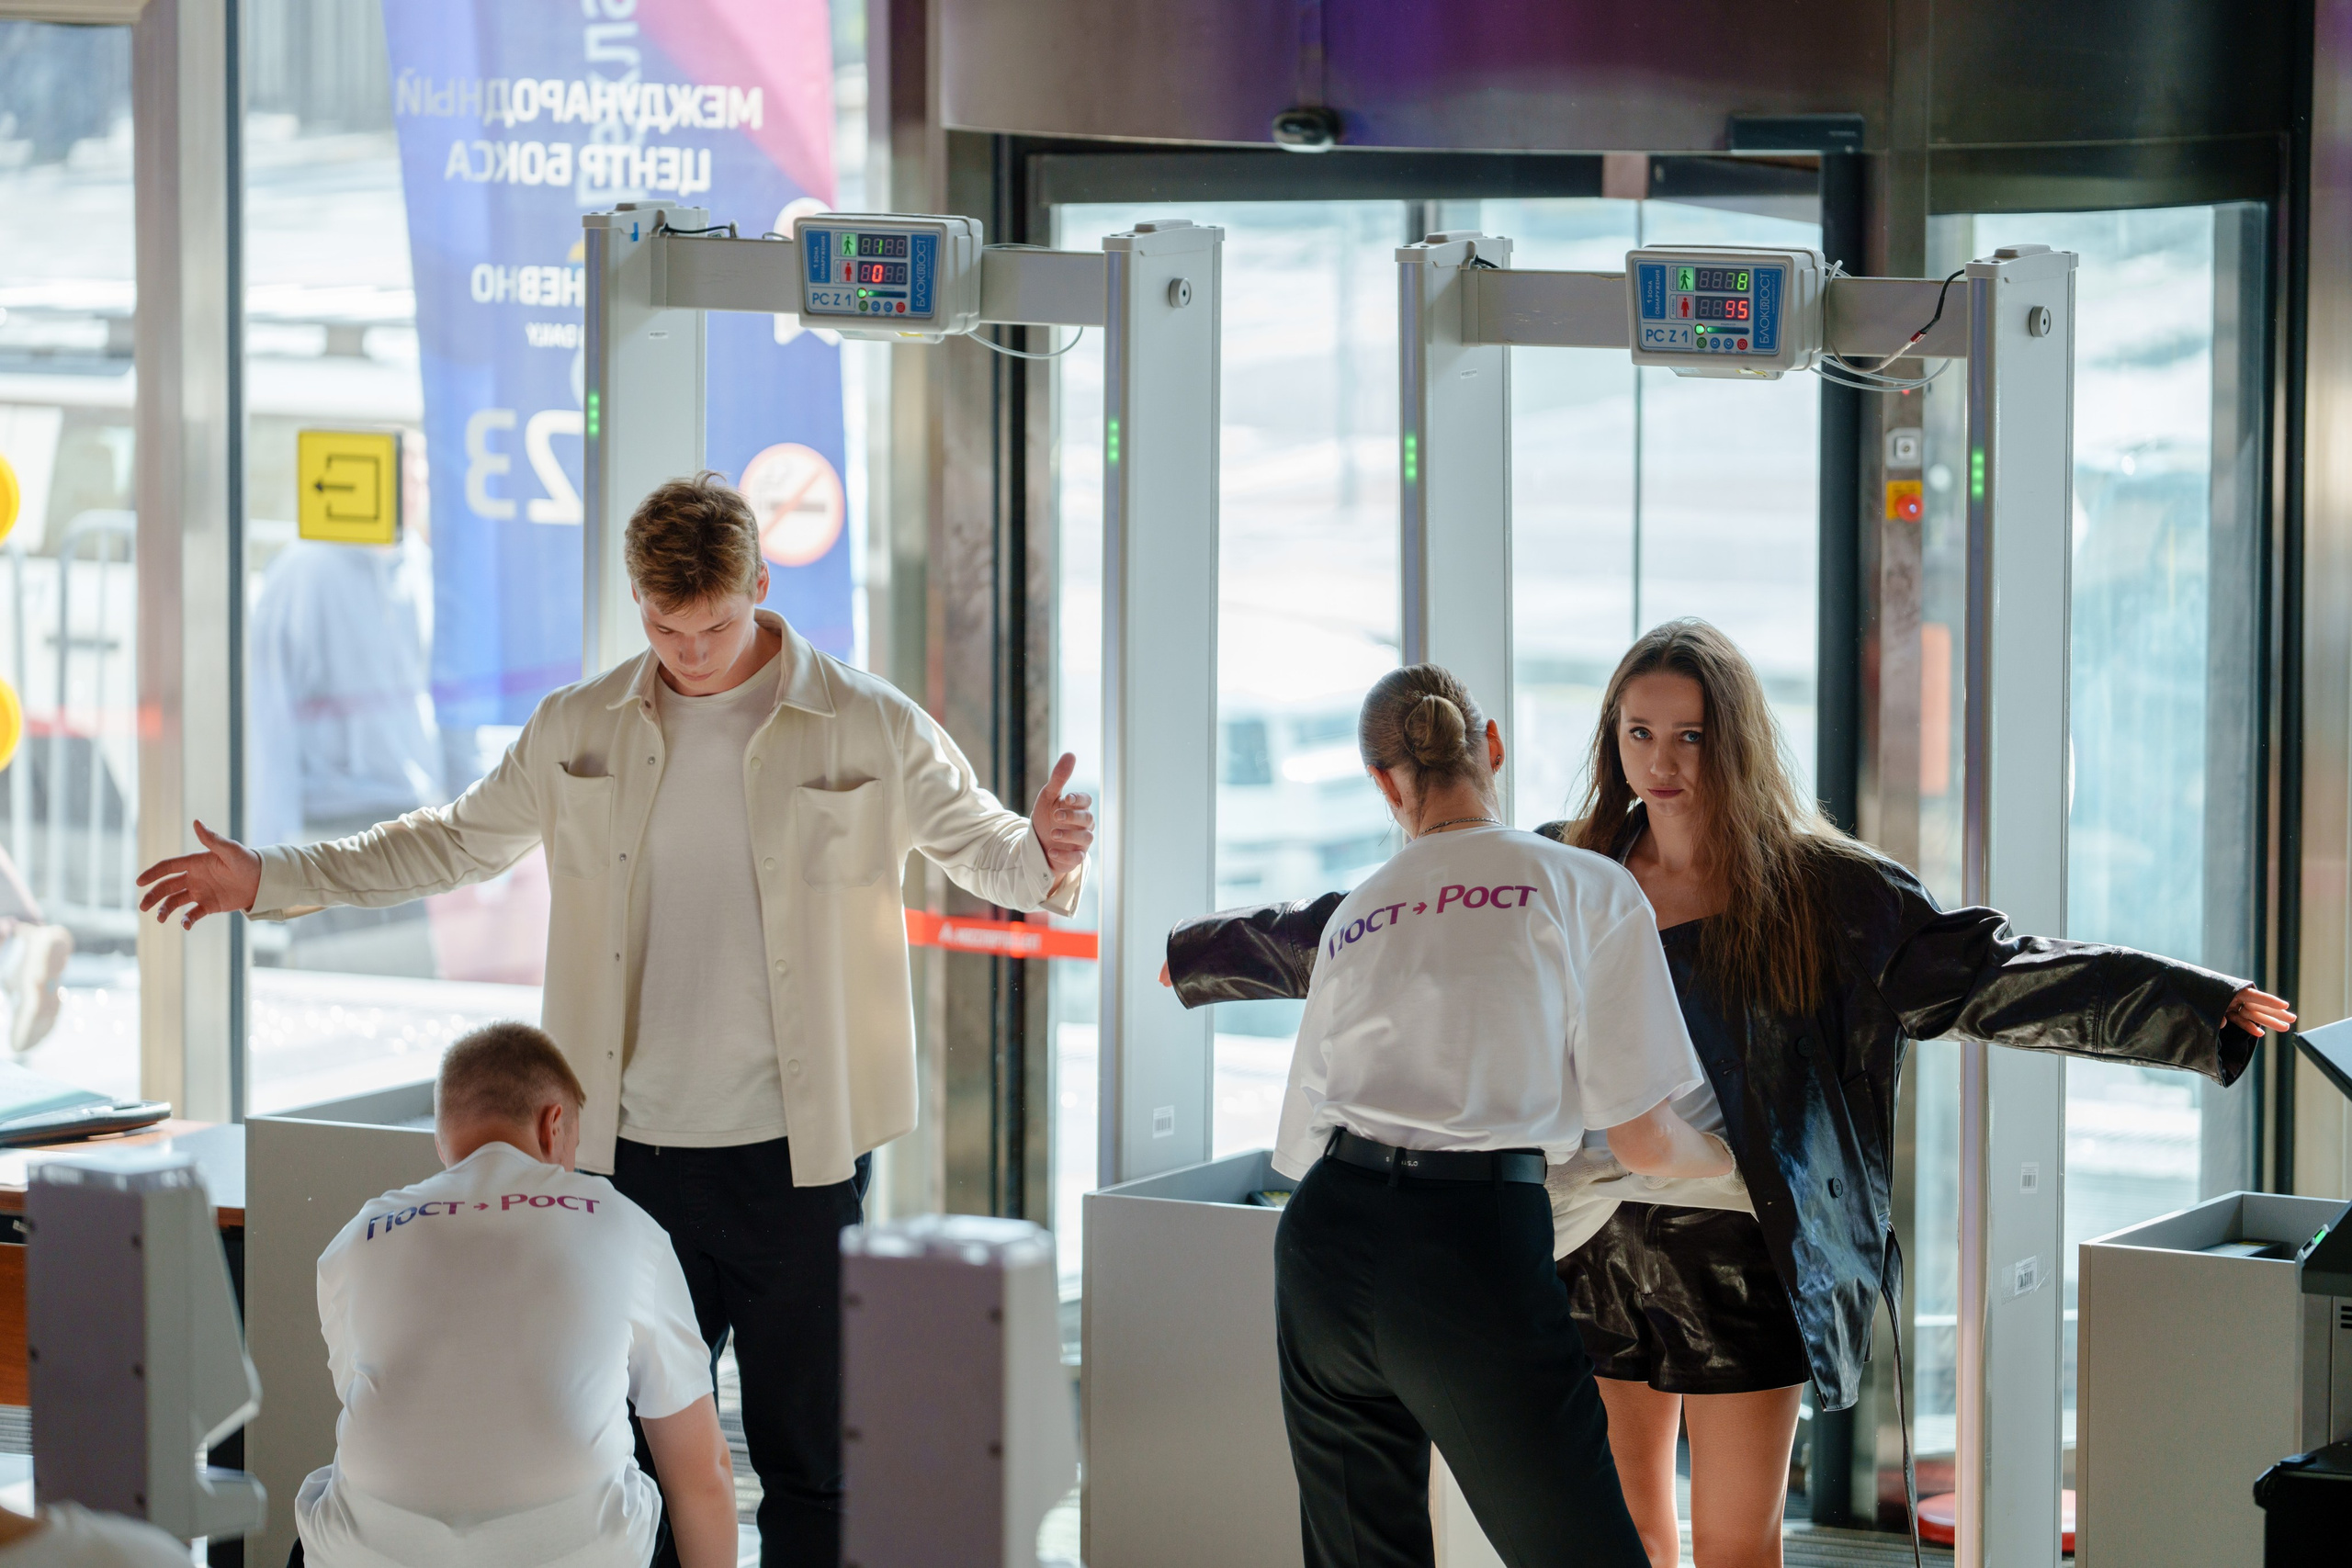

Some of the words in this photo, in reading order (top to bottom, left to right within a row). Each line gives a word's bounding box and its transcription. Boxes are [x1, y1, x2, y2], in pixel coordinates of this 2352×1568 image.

[844, 294, 851, 306] 1
[1724, 299, 1748, 320] 95
[1680, 330, 1688, 344] 1
